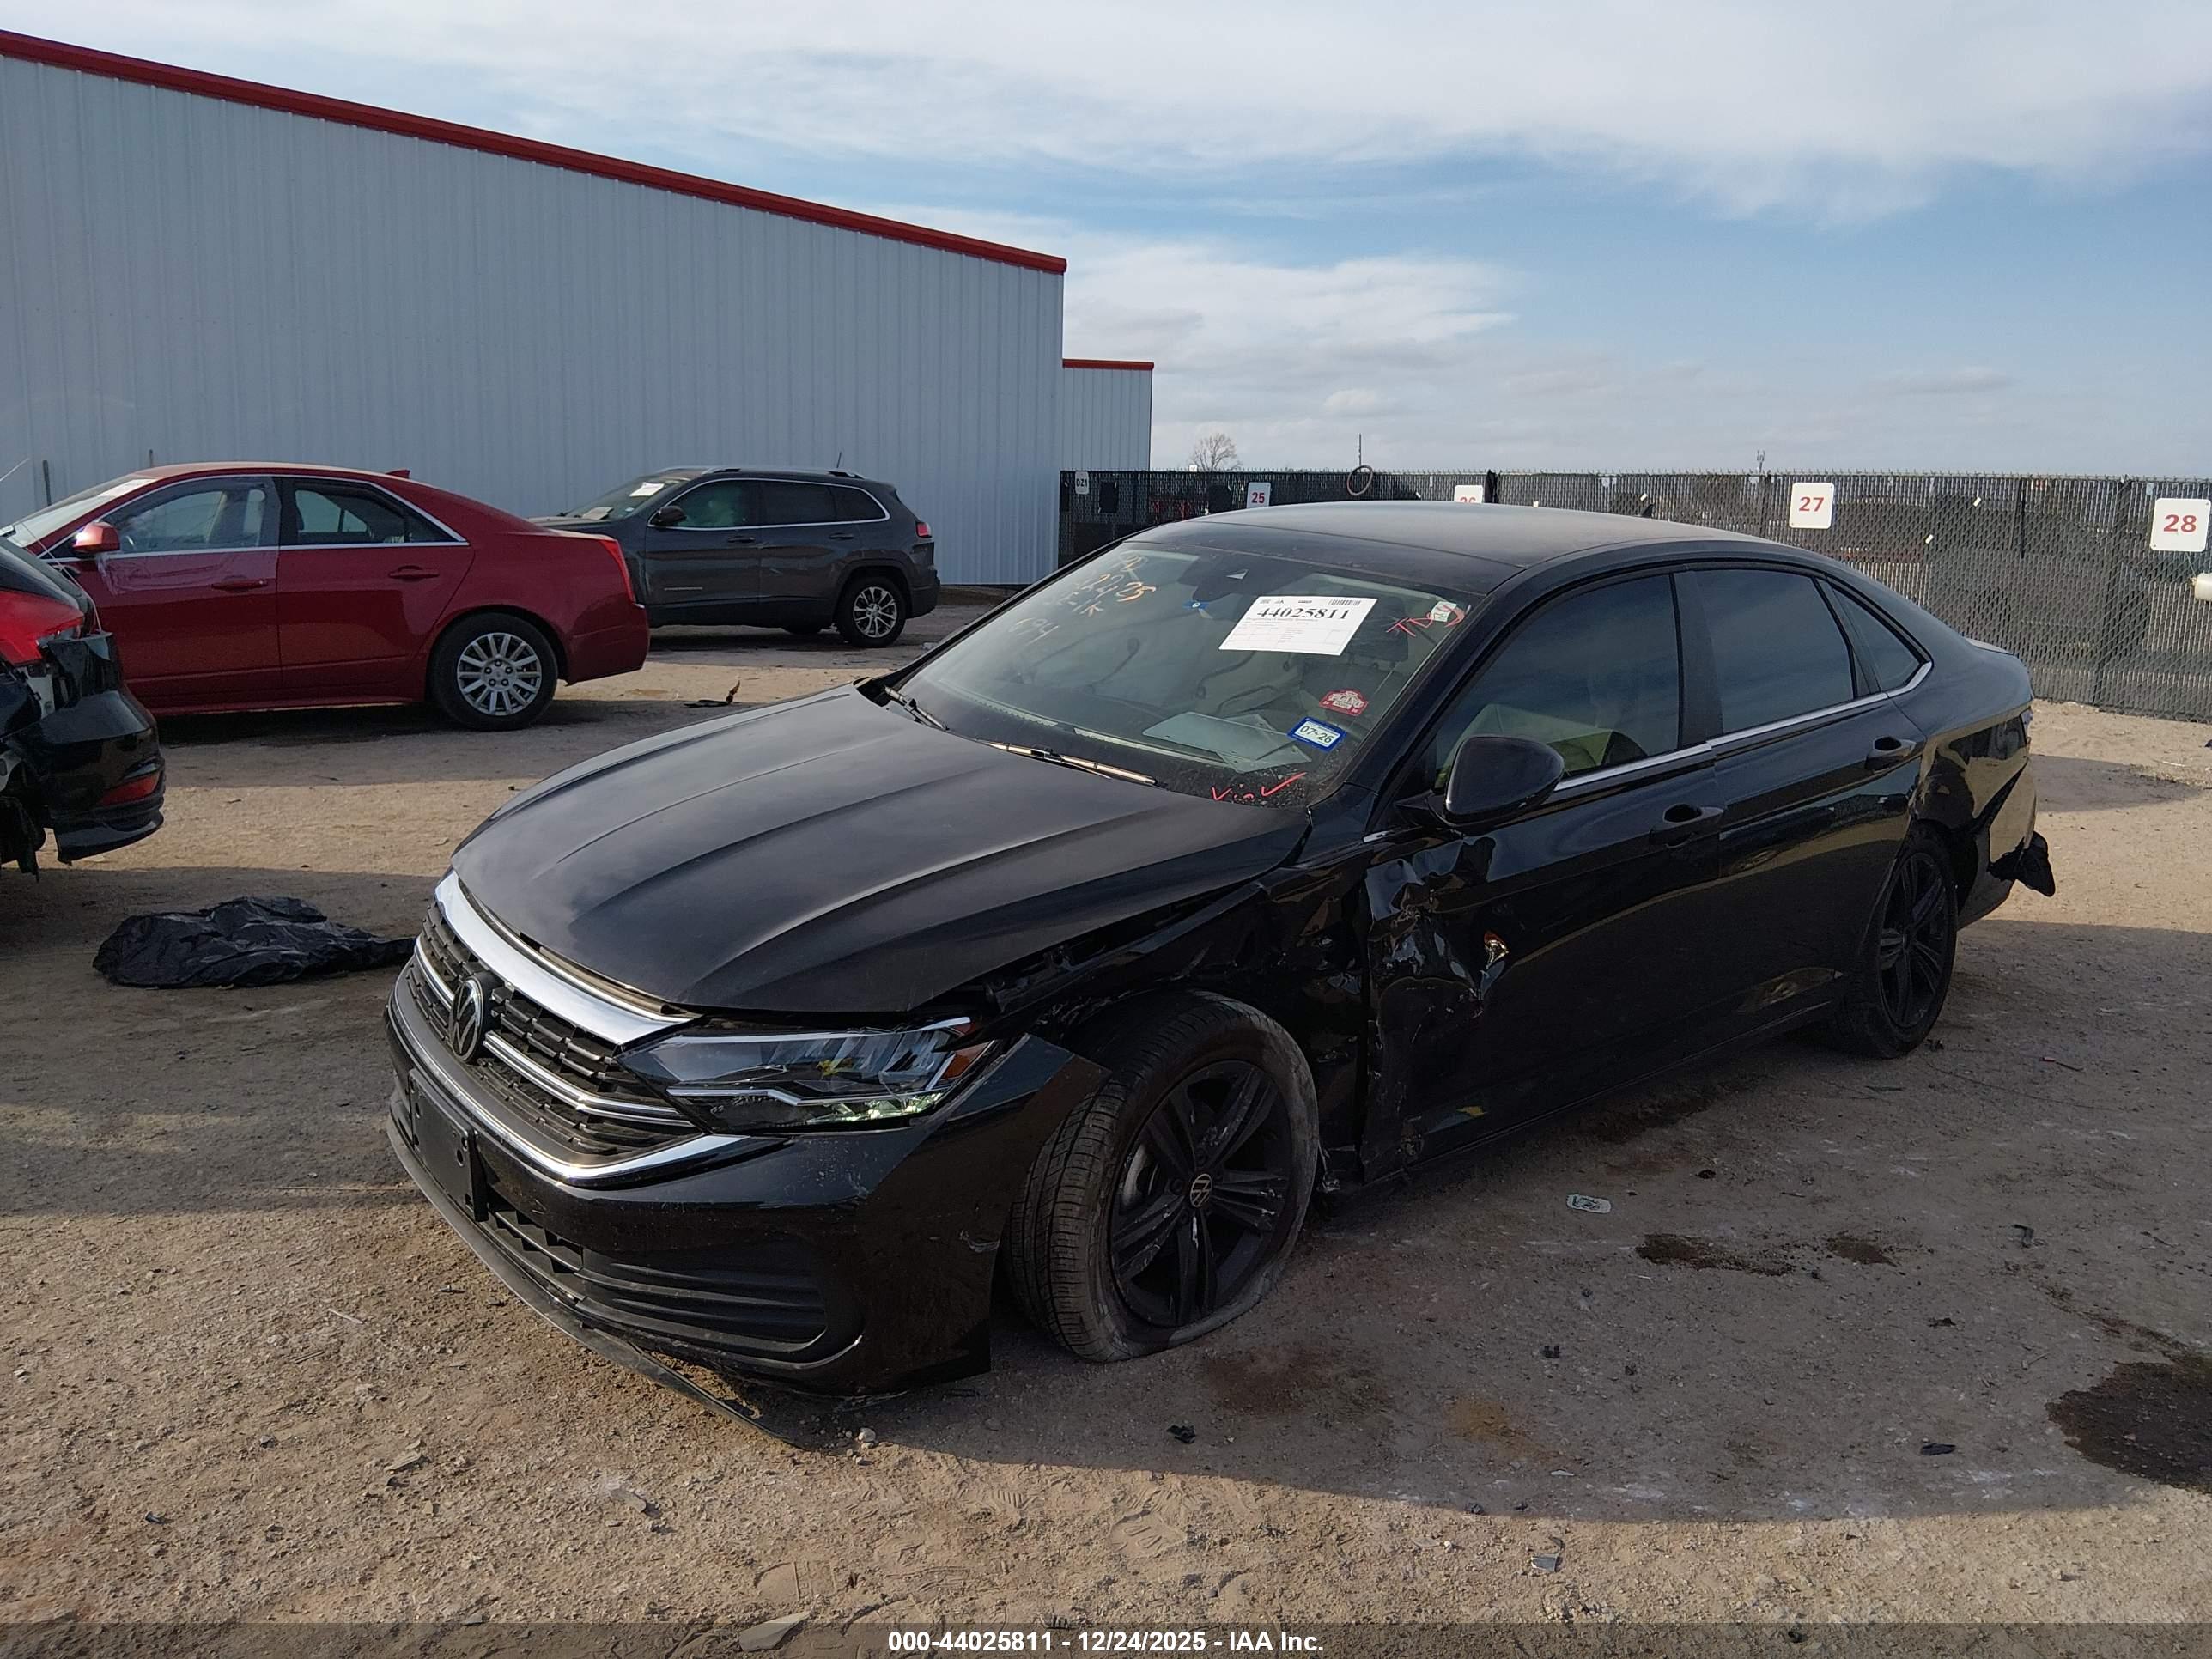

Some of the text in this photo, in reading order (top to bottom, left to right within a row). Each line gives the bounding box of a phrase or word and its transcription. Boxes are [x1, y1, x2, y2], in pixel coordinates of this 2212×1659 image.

[1251, 491, 1265, 504] 25
[1799, 496, 1825, 513] 27
[2163, 514, 2197, 533] 28
[1256, 606, 1350, 620] 44025811
